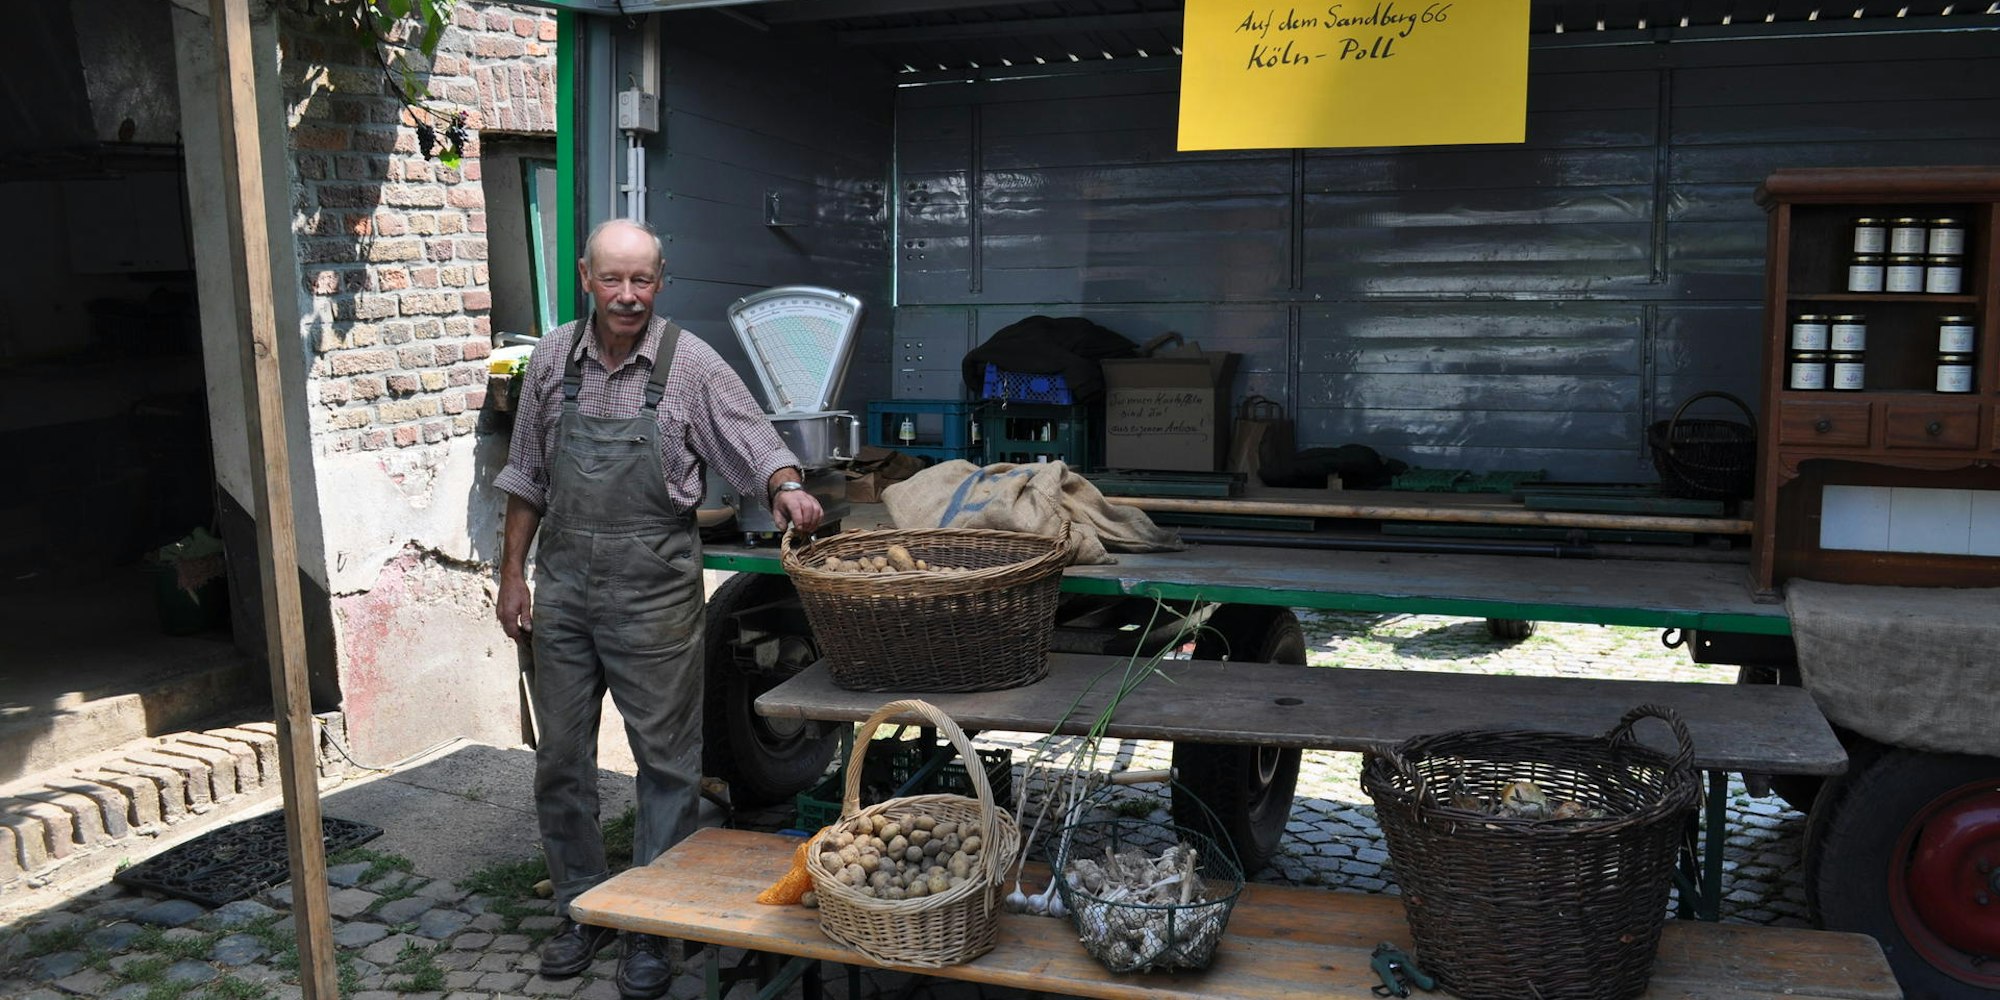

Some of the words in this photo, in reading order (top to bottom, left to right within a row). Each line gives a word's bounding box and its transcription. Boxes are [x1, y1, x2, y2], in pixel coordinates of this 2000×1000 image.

[1235, 9, 1275, 39] Auf
[1278, 8, 1317, 31] dem
[1323, 2, 1417, 38] Sandberg
[1421, 3, 1453, 23] 66
[1338, 36, 1396, 60] Poll
